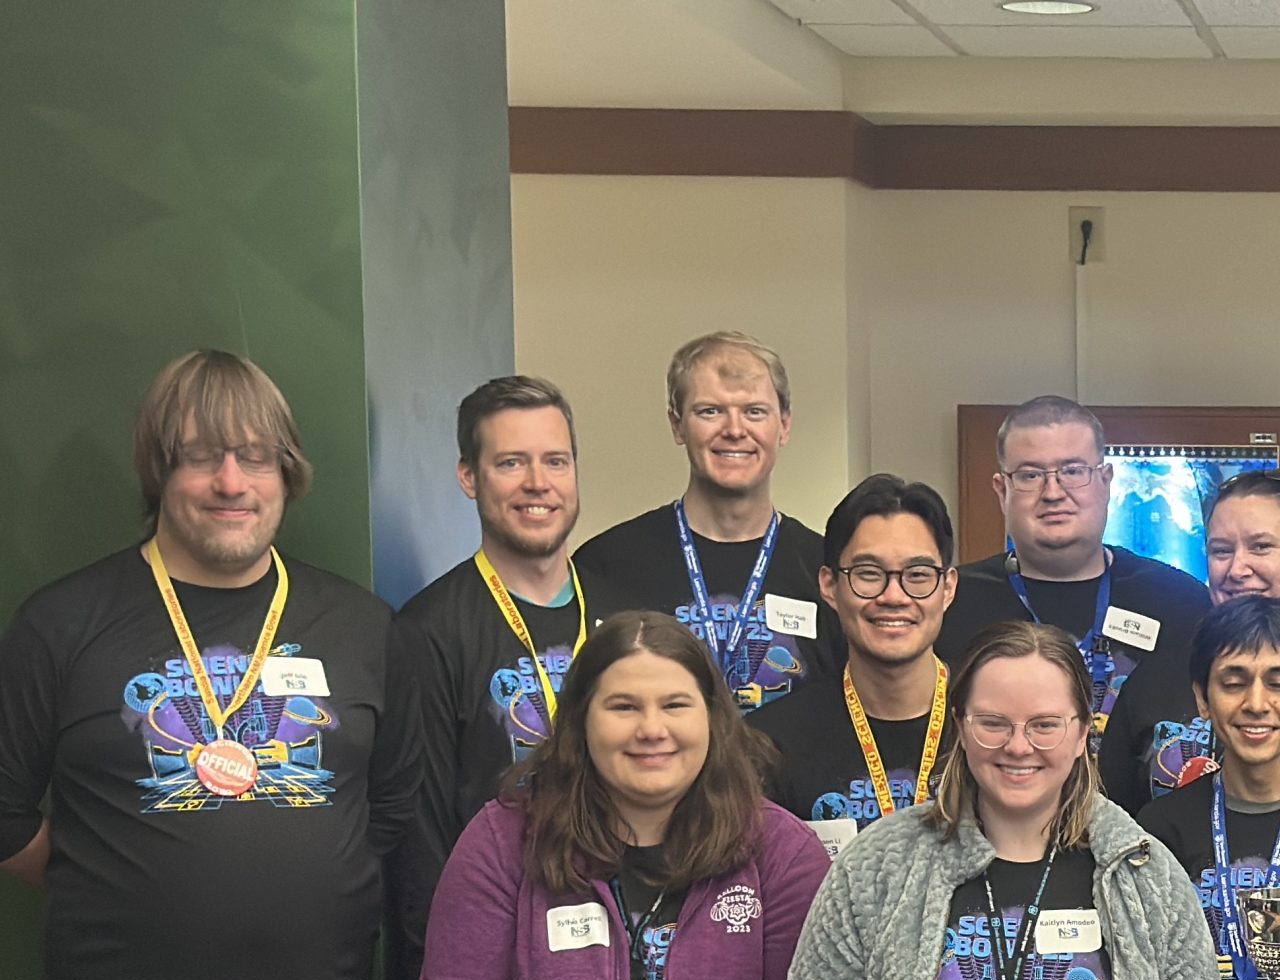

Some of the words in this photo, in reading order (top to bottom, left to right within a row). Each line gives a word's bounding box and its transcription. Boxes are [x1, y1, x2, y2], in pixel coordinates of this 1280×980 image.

[931, 678, 948, 731] MEXICO
[196, 751, 255, 782] OFFICIAL
[866, 751, 894, 811] MEXICO
[1039, 919, 1066, 927] Kaitlyn
